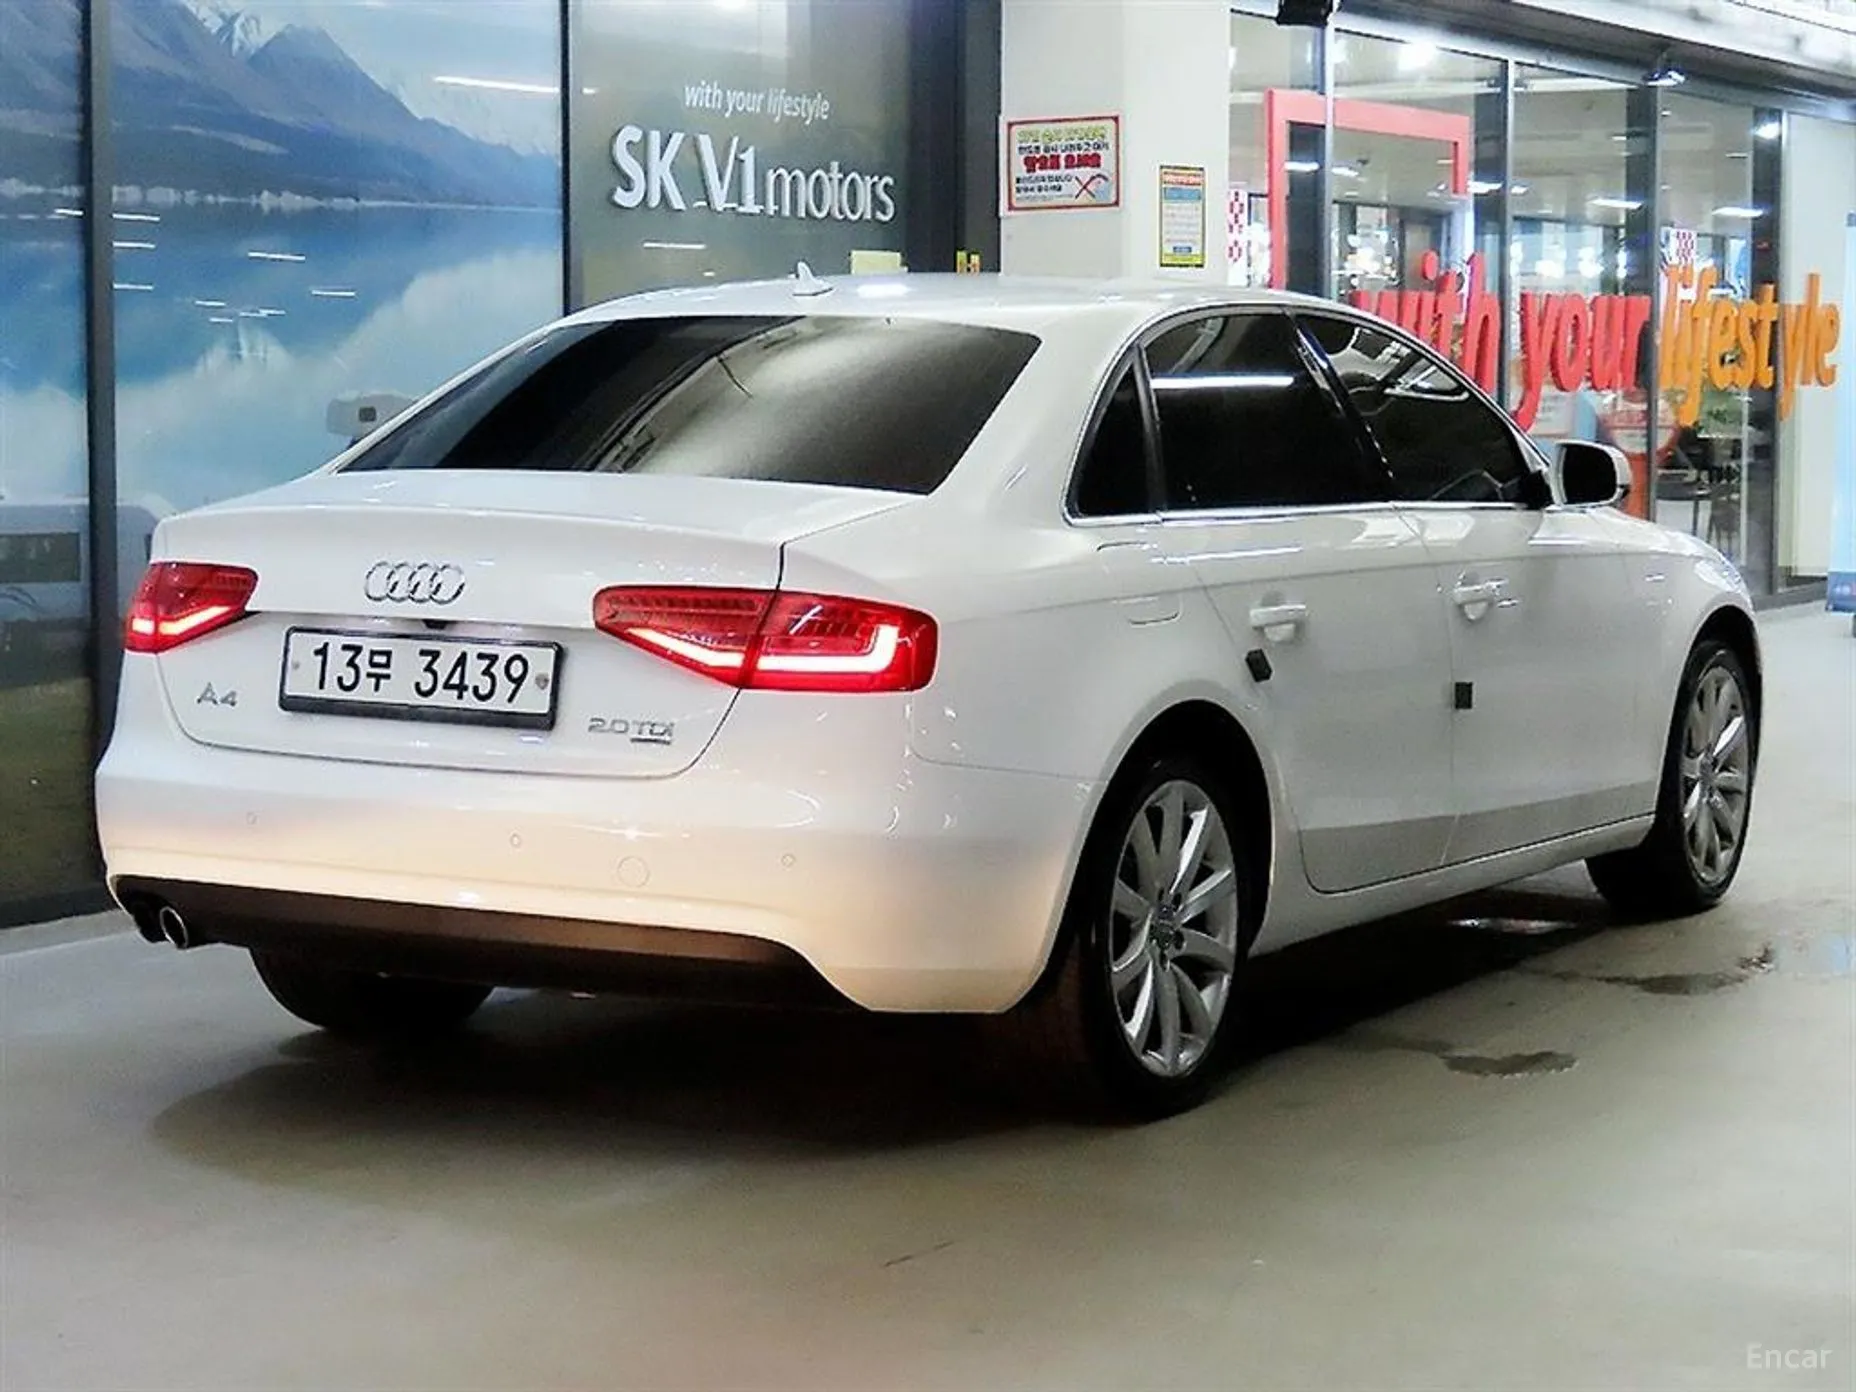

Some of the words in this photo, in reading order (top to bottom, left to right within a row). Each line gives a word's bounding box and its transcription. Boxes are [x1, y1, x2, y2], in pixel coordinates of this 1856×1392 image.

[684, 80, 723, 111] with
[725, 88, 765, 118] your
[767, 87, 830, 125] lifestyle
[611, 124, 686, 211] SK
[1510, 291, 1651, 434] your
[1659, 265, 1841, 427] lifestyle
[196, 682, 238, 707] A4
[313, 641, 393, 693] 13무
[414, 649, 529, 704] 3439
